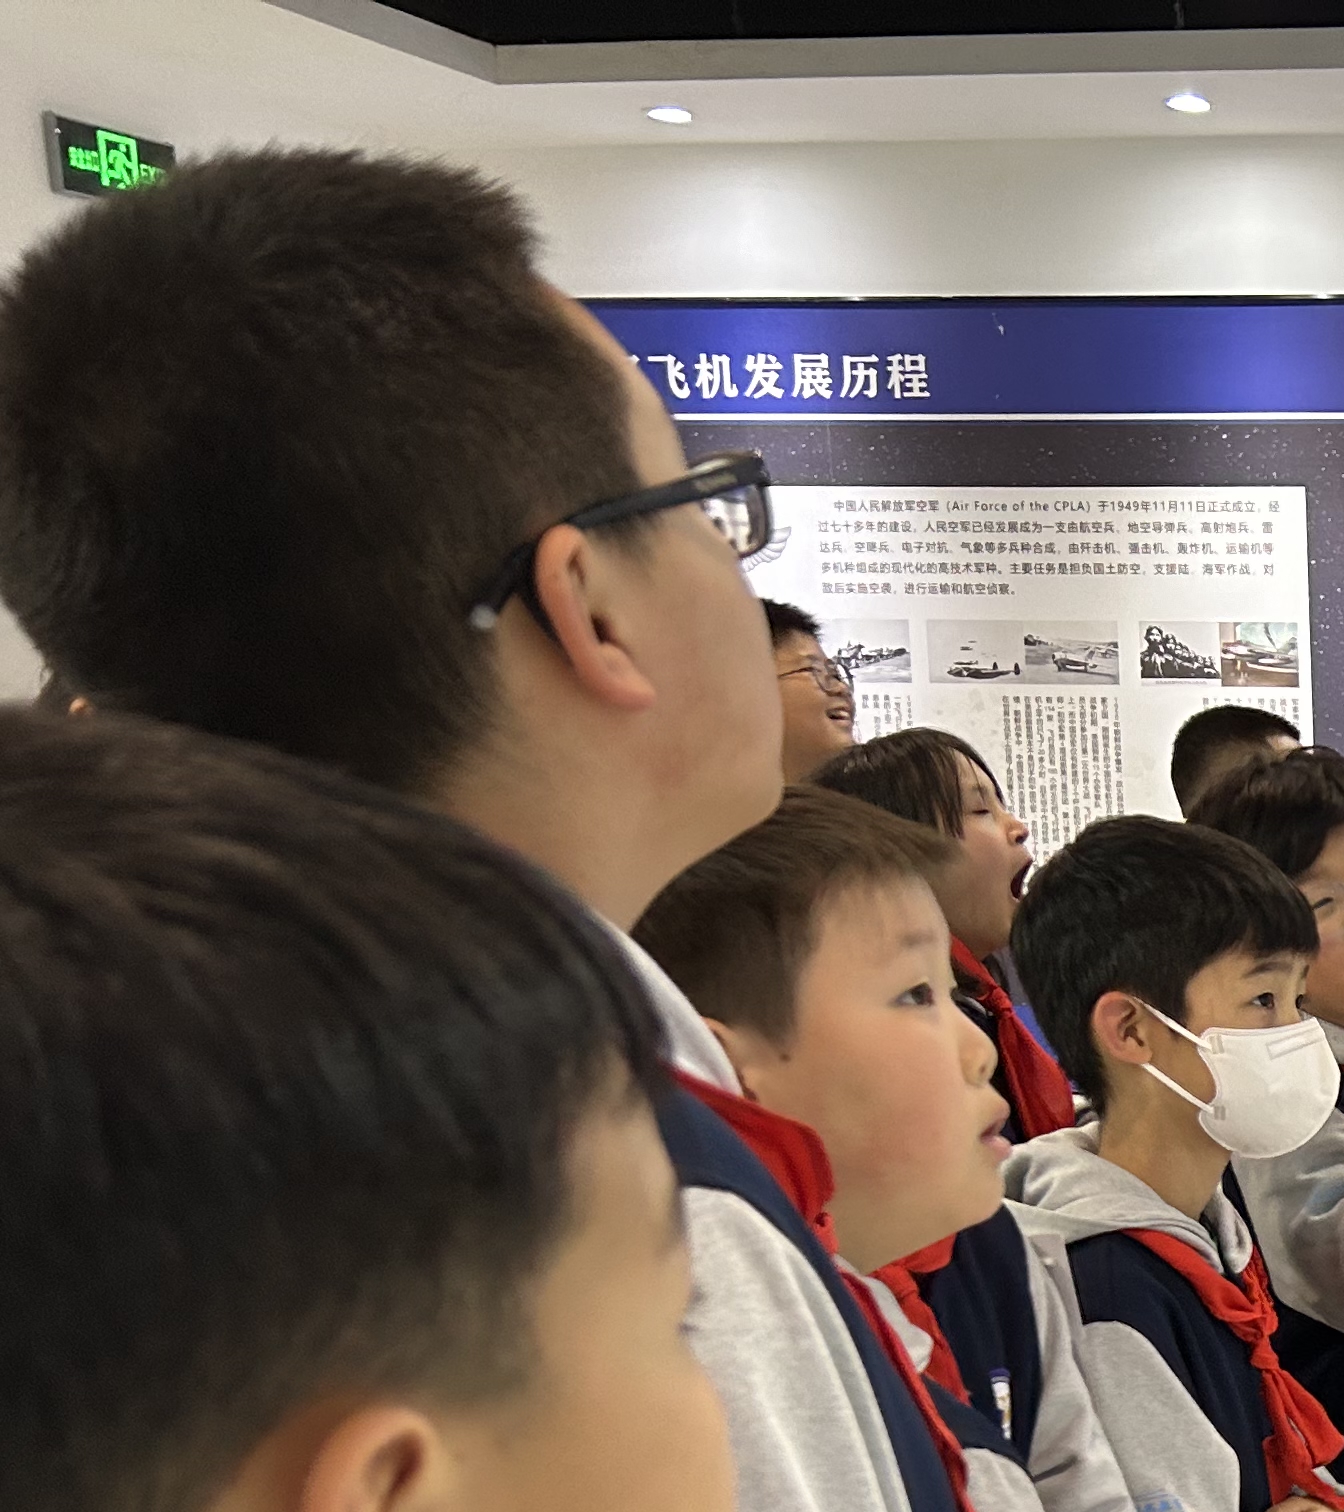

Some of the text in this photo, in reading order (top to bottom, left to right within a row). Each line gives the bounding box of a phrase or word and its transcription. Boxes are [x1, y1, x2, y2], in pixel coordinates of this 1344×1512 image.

[628, 353, 931, 400] 飞机发展历程
[974, 501, 1007, 512] Force
[1012, 500, 1025, 512] of
[1029, 500, 1049, 512] the
